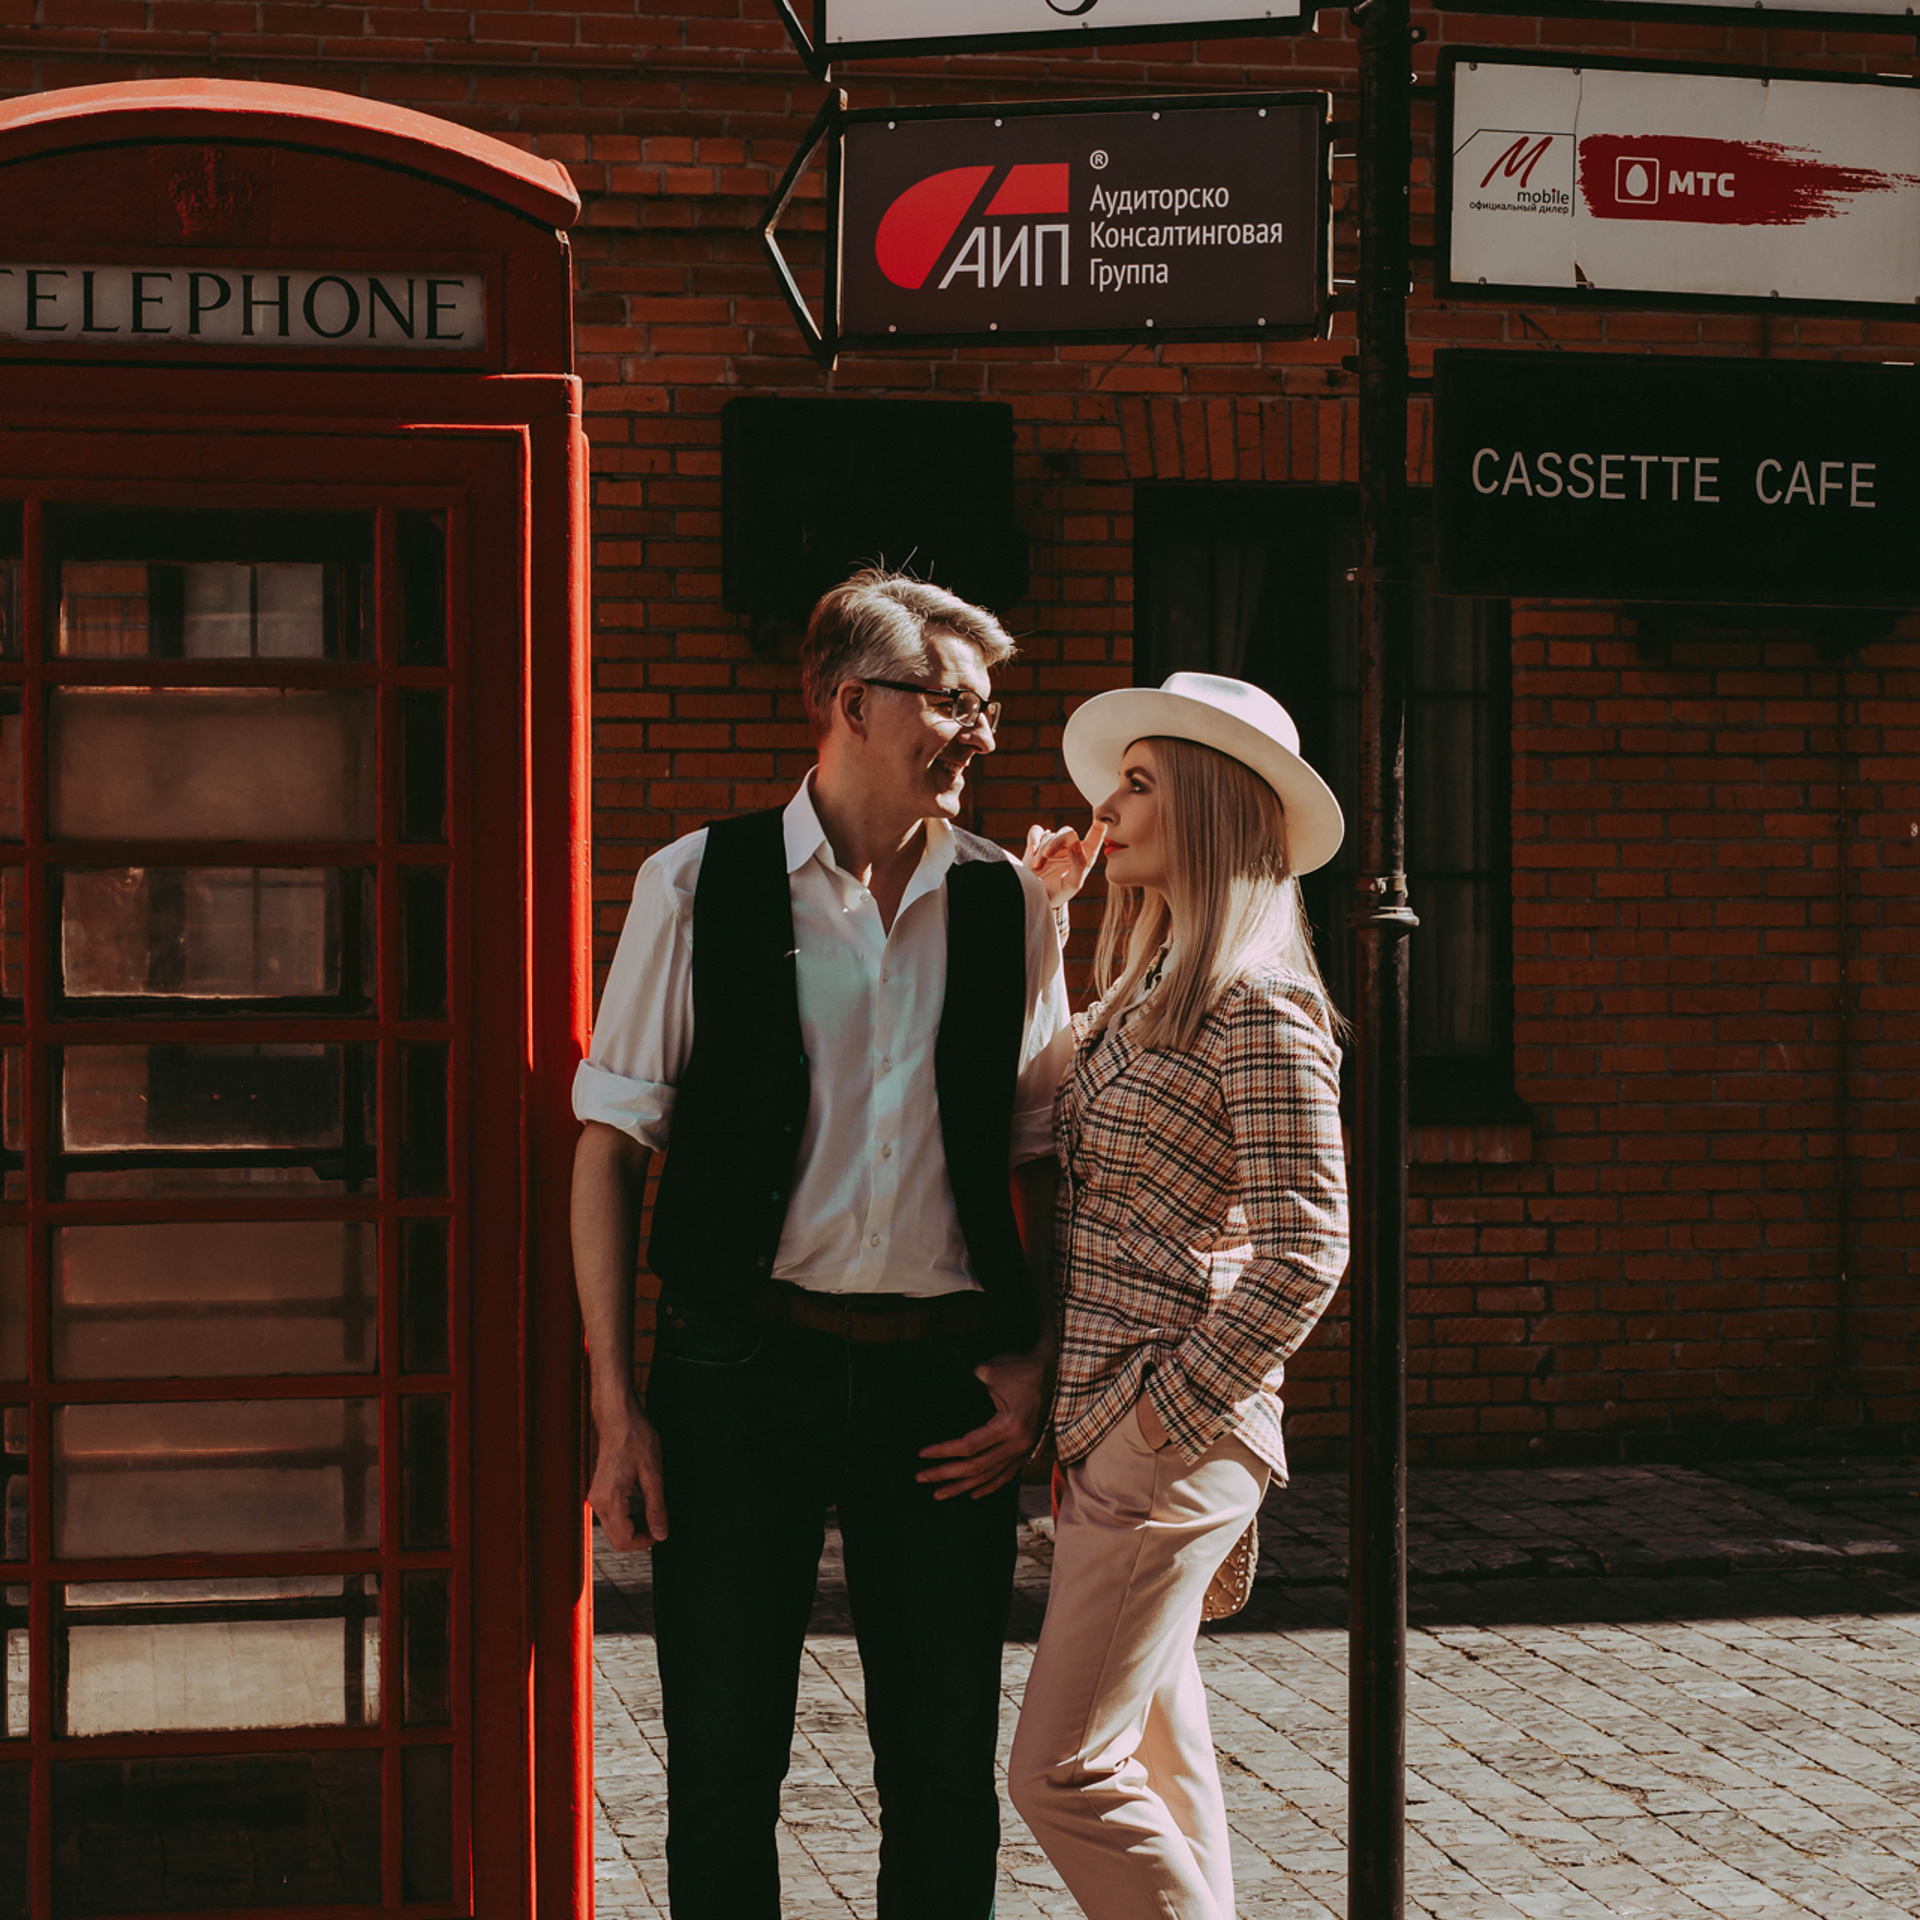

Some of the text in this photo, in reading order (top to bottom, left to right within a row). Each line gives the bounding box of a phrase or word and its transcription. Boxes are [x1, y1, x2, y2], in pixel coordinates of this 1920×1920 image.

[1516, 189, 1570, 205] mobile
[1668, 170, 1736, 198] МТС
[1089, 184, 1230, 218] Аудиторско
[1469, 200, 1570, 215] официальный дилер
[1089, 221, 1284, 249] Консалтинговая
[937, 223, 1070, 290] АИП
[1089, 258, 1170, 293] Группа
[1471, 447, 1878, 509] CASSETTE CAFE
